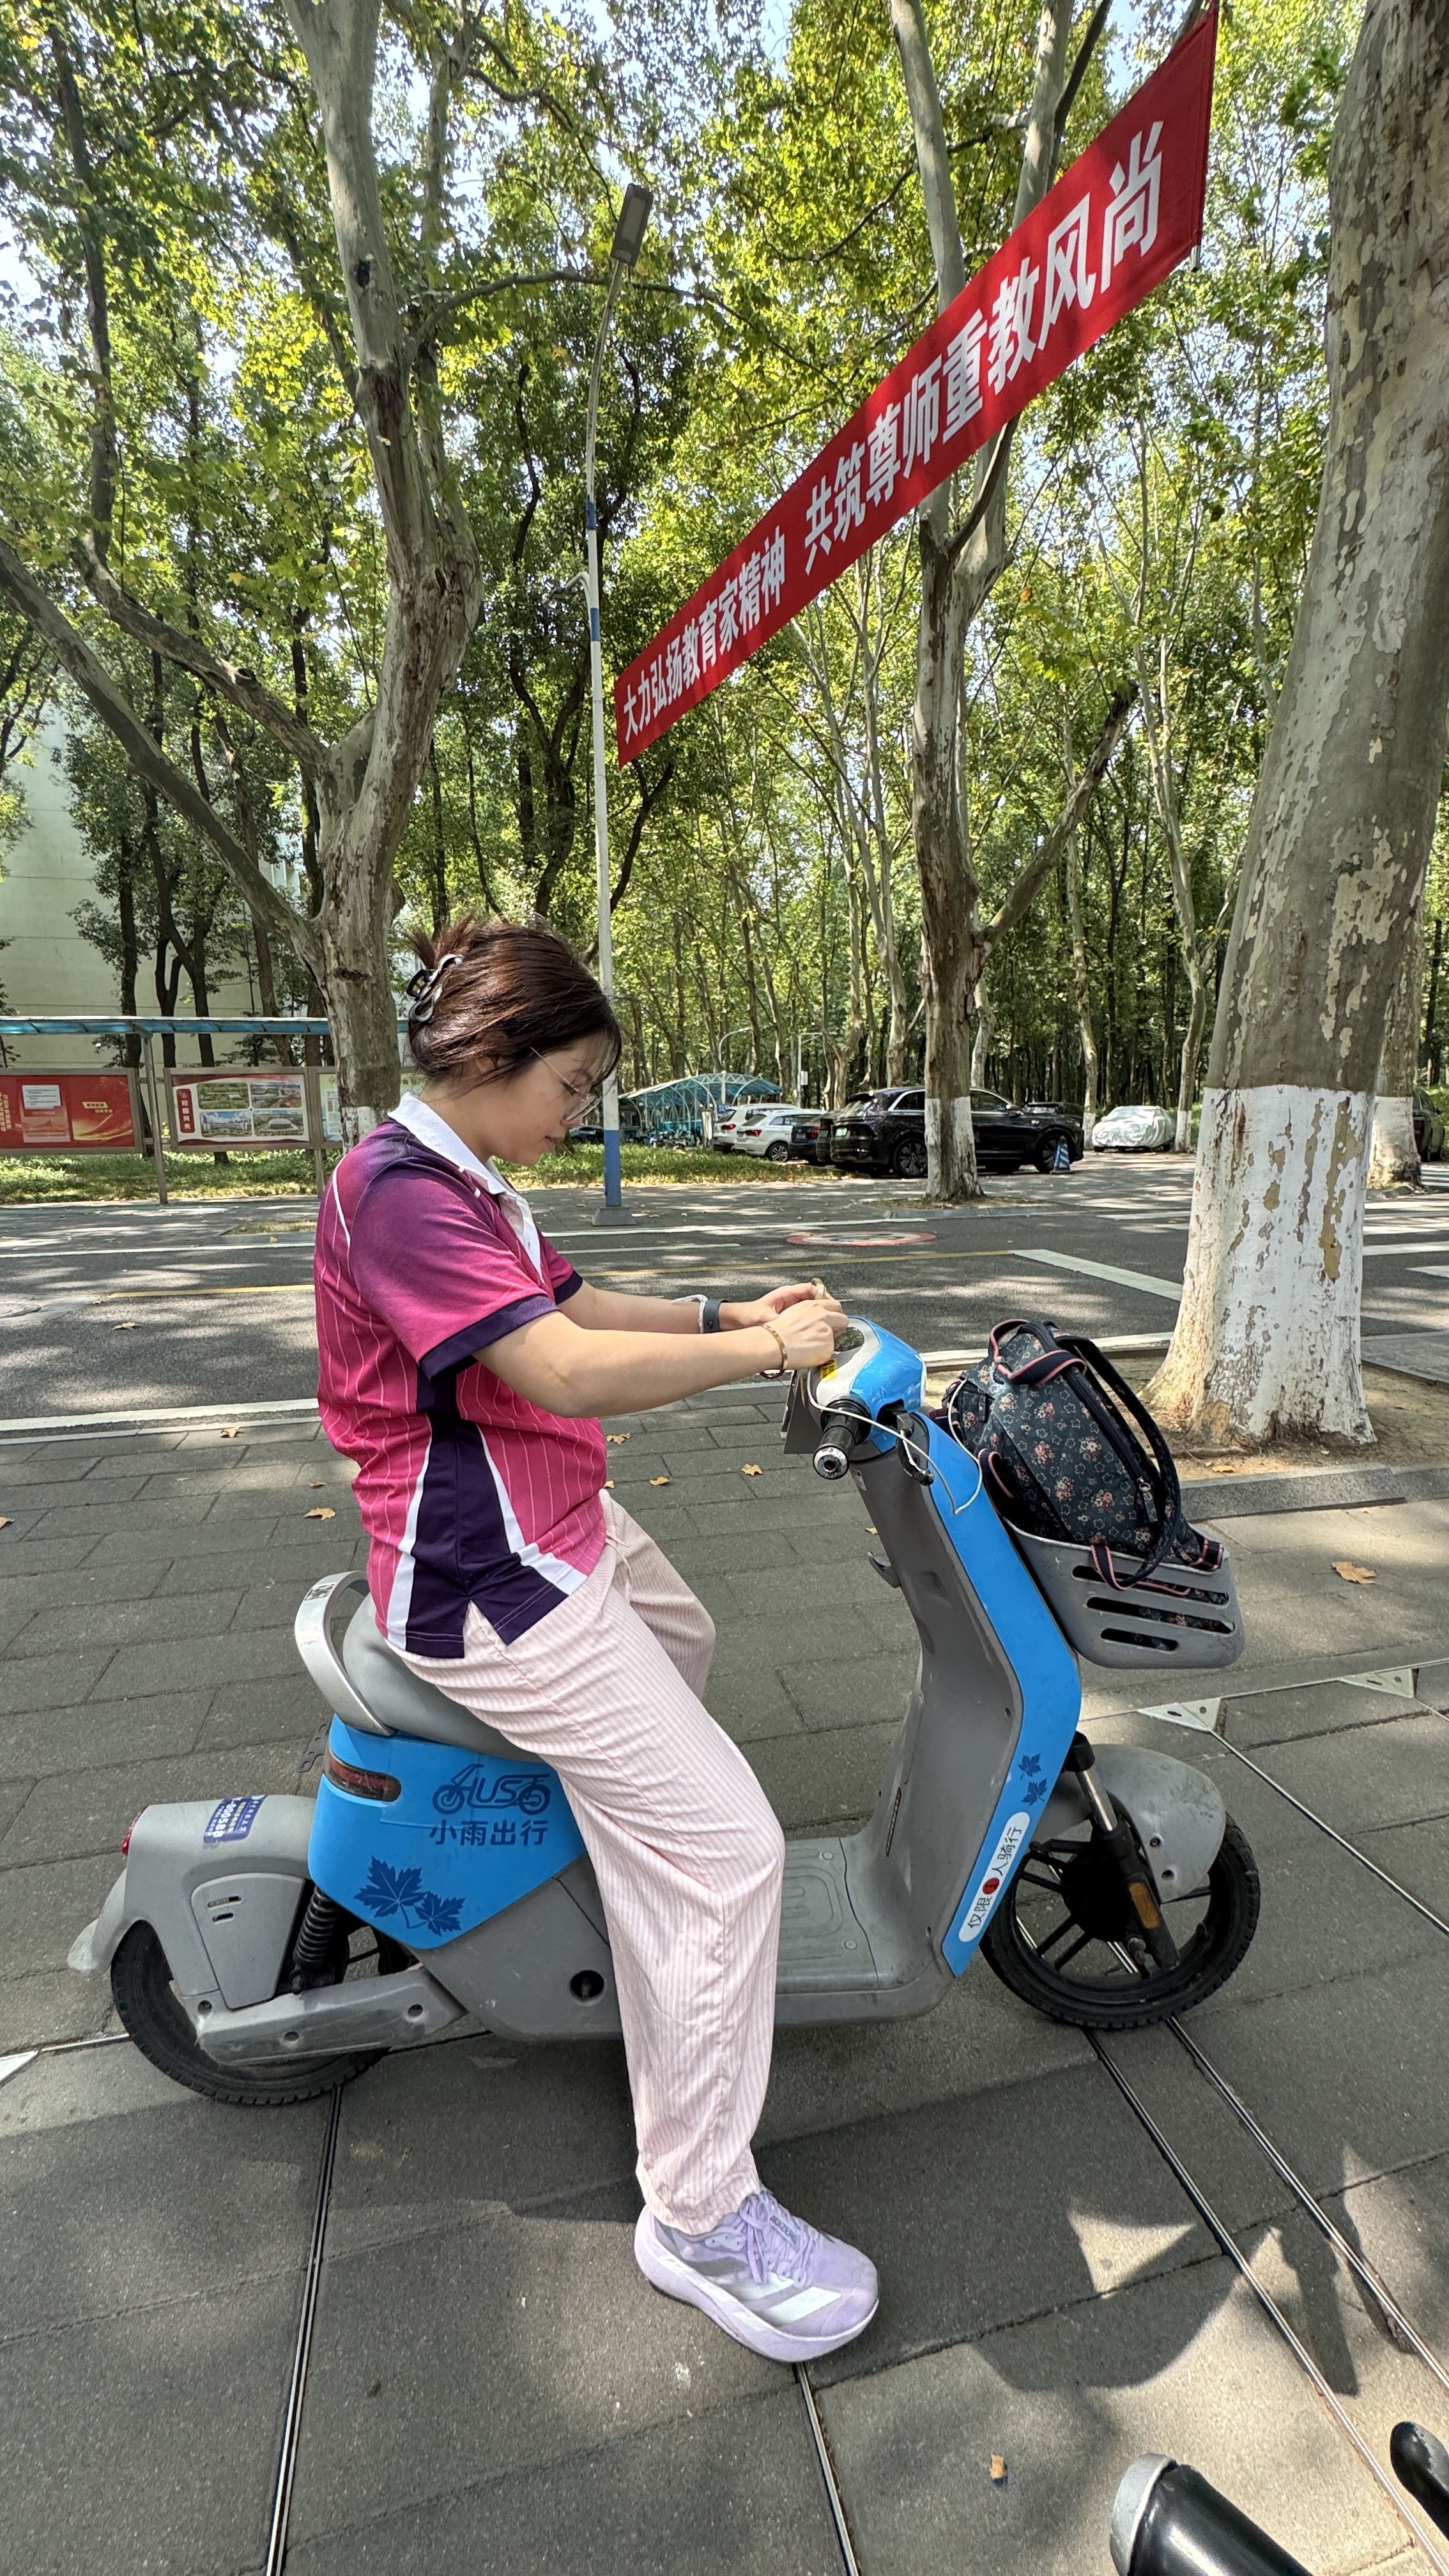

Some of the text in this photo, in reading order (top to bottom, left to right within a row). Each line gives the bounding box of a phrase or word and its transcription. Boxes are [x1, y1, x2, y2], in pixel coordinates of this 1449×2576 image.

[624, 121, 1164, 745] 大力弘扬教育家精神 共筑尊师重教风尚
[429, 1820, 548, 1846] 小雨出行
[967, 1826, 1022, 1929] 仅限1人骑行
